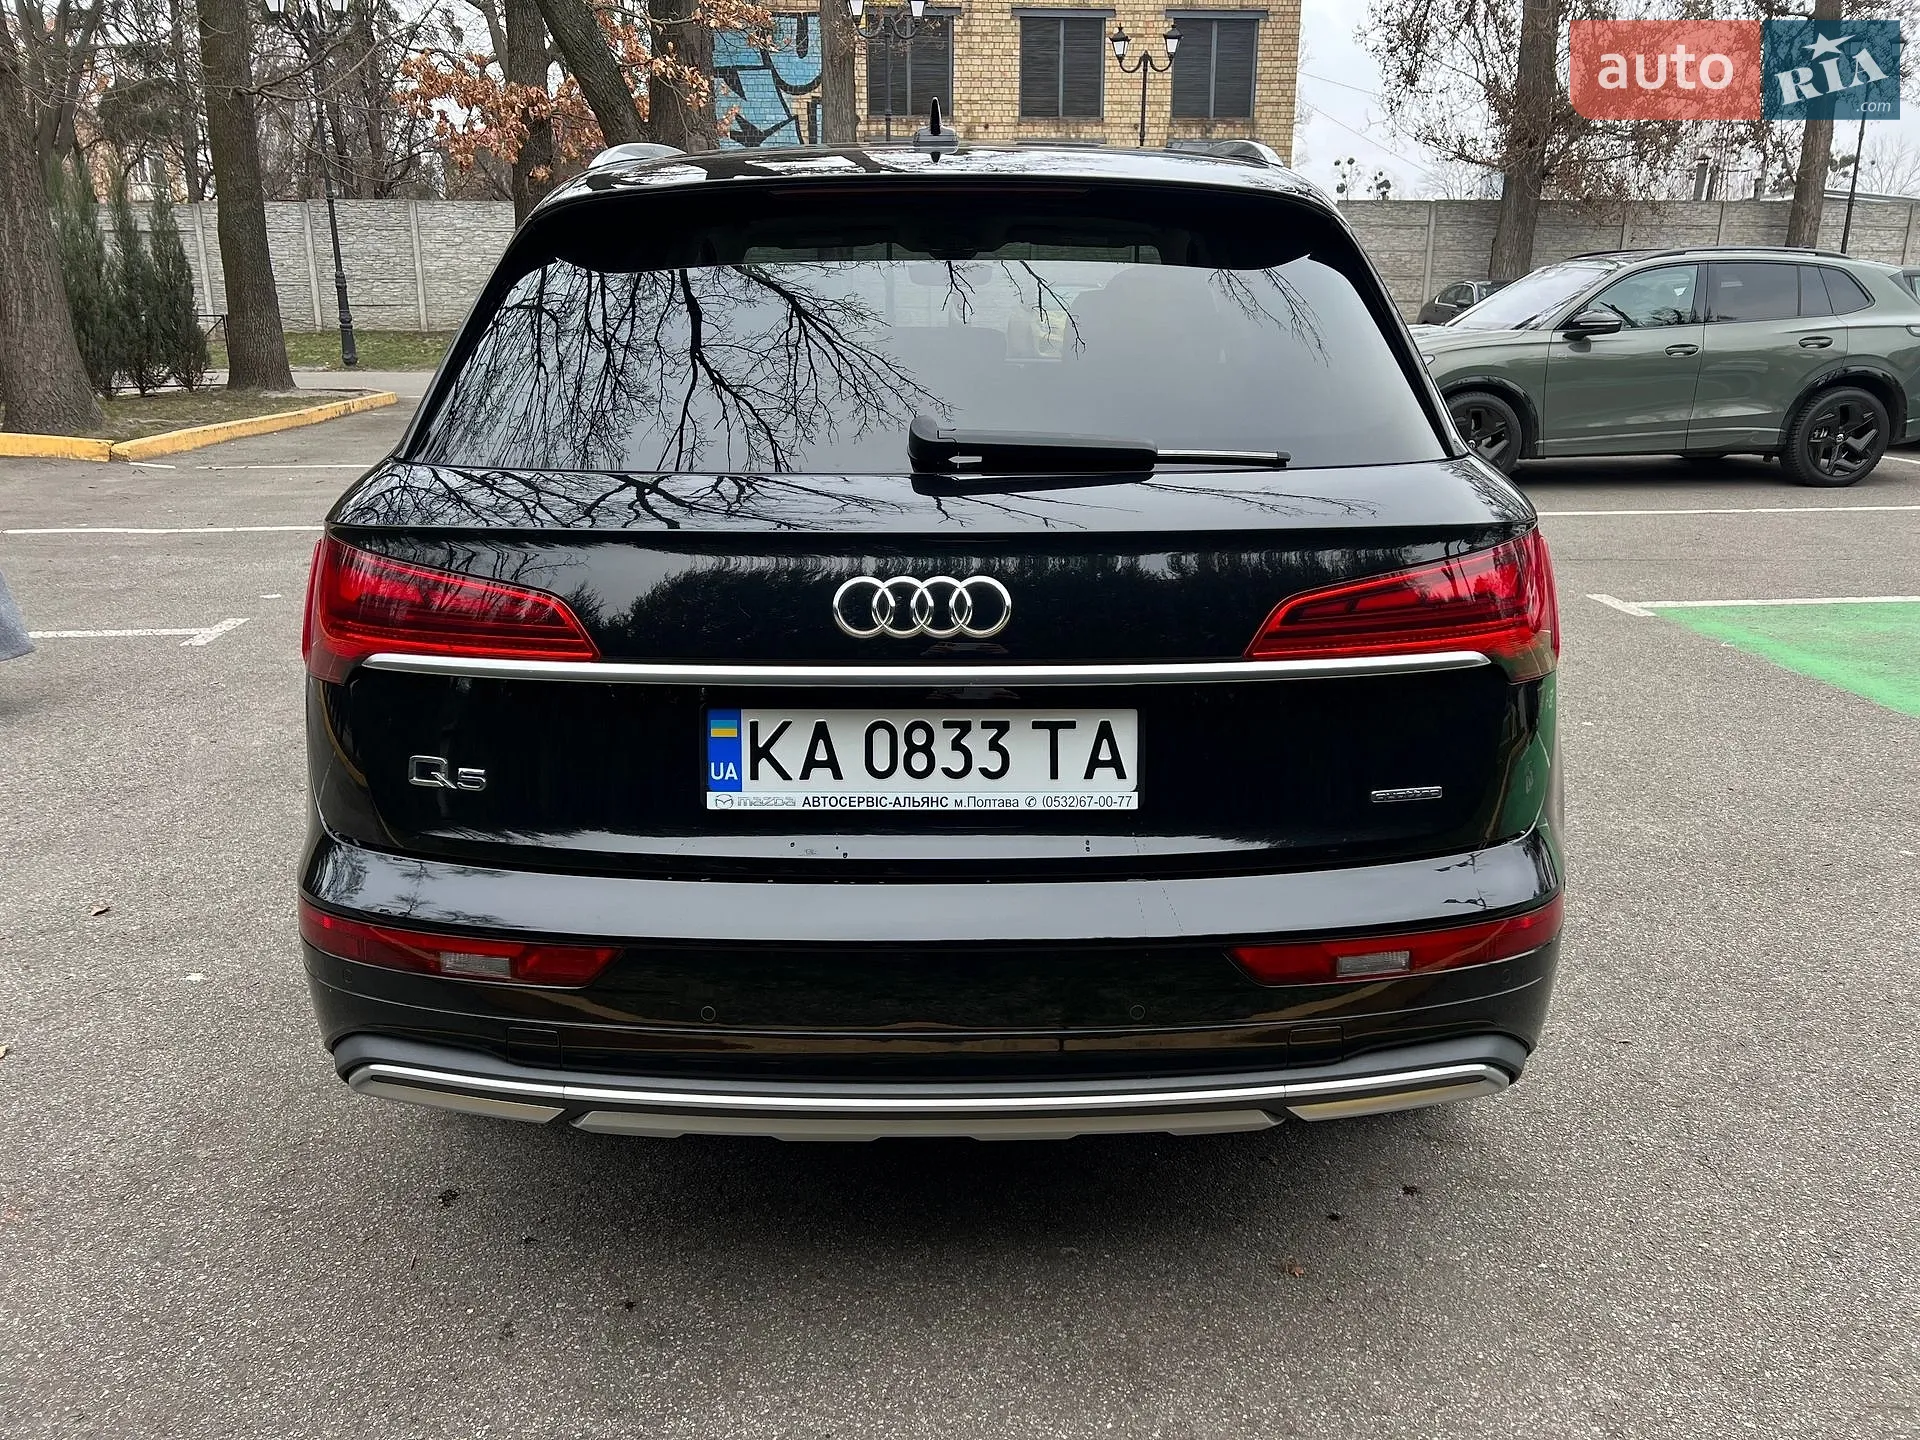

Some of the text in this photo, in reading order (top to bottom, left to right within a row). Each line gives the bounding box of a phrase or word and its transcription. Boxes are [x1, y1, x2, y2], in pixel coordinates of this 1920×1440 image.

[749, 719, 1128, 781] KA 0833 TA
[408, 755, 487, 791] Q5
[711, 762, 738, 780] UA
[802, 796, 949, 809] АВТОСЕРВІС-АЛЬЯНС
[954, 796, 1019, 808] м.Полтава
[1042, 795, 1133, 809] (0532)67-00-77
